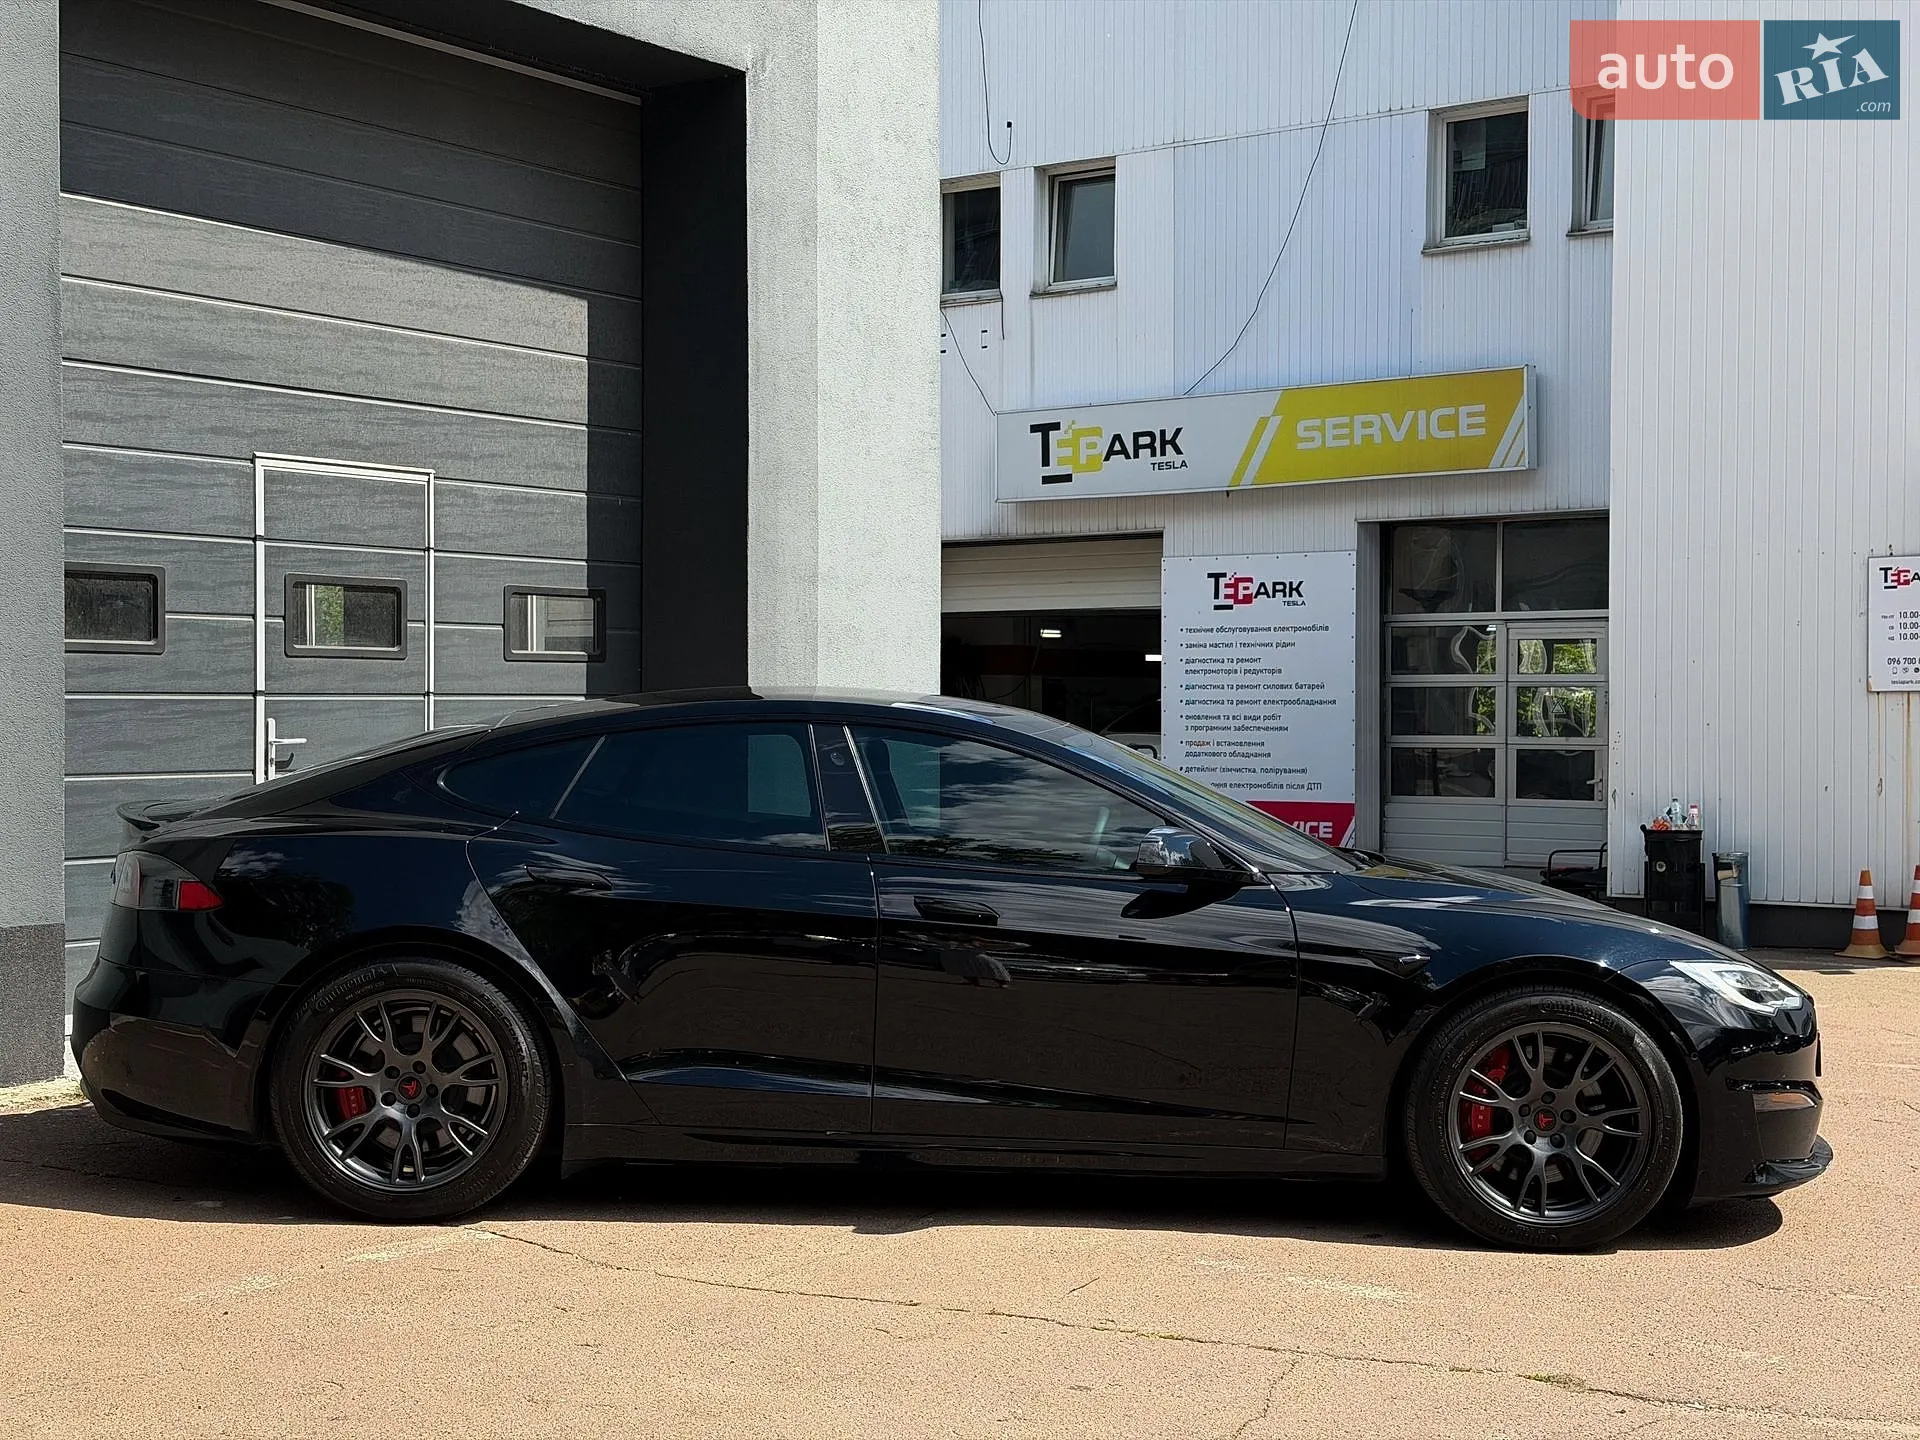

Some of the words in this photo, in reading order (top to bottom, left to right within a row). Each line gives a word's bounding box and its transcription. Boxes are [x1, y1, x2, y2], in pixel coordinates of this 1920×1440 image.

[1296, 404, 1486, 450] SERVICE
[1150, 460, 1188, 471] TESLA
[1215, 625, 1271, 635] обслуговування
[1273, 624, 1329, 634] електромобілів
[1275, 640, 1295, 649] рідин
[1185, 656, 1224, 665] діагностика
[1235, 657, 1261, 665] ремонт
[1887, 657, 1901, 665] 096
[1902, 657, 1916, 665] 700
[1185, 667, 1238, 676] електромоторів
[1243, 667, 1282, 676] редукторів
[1185, 682, 1224, 690] діагностика
[1295, 682, 1325, 691] батарей
[1185, 697, 1224, 706] діагностика
[1235, 699, 1261, 707] ремонт
[1263, 698, 1337, 706] електрообладнання
[1263, 713, 1281, 722] робіт
[1185, 740, 1211, 748] продаж
[1228, 750, 1271, 758] обладнання
[1185, 765, 1218, 773] детейлінг
[1260, 766, 1308, 775] полірування)
[1229, 782, 1284, 790] електромобілів
[1285, 782, 1305, 790] після
